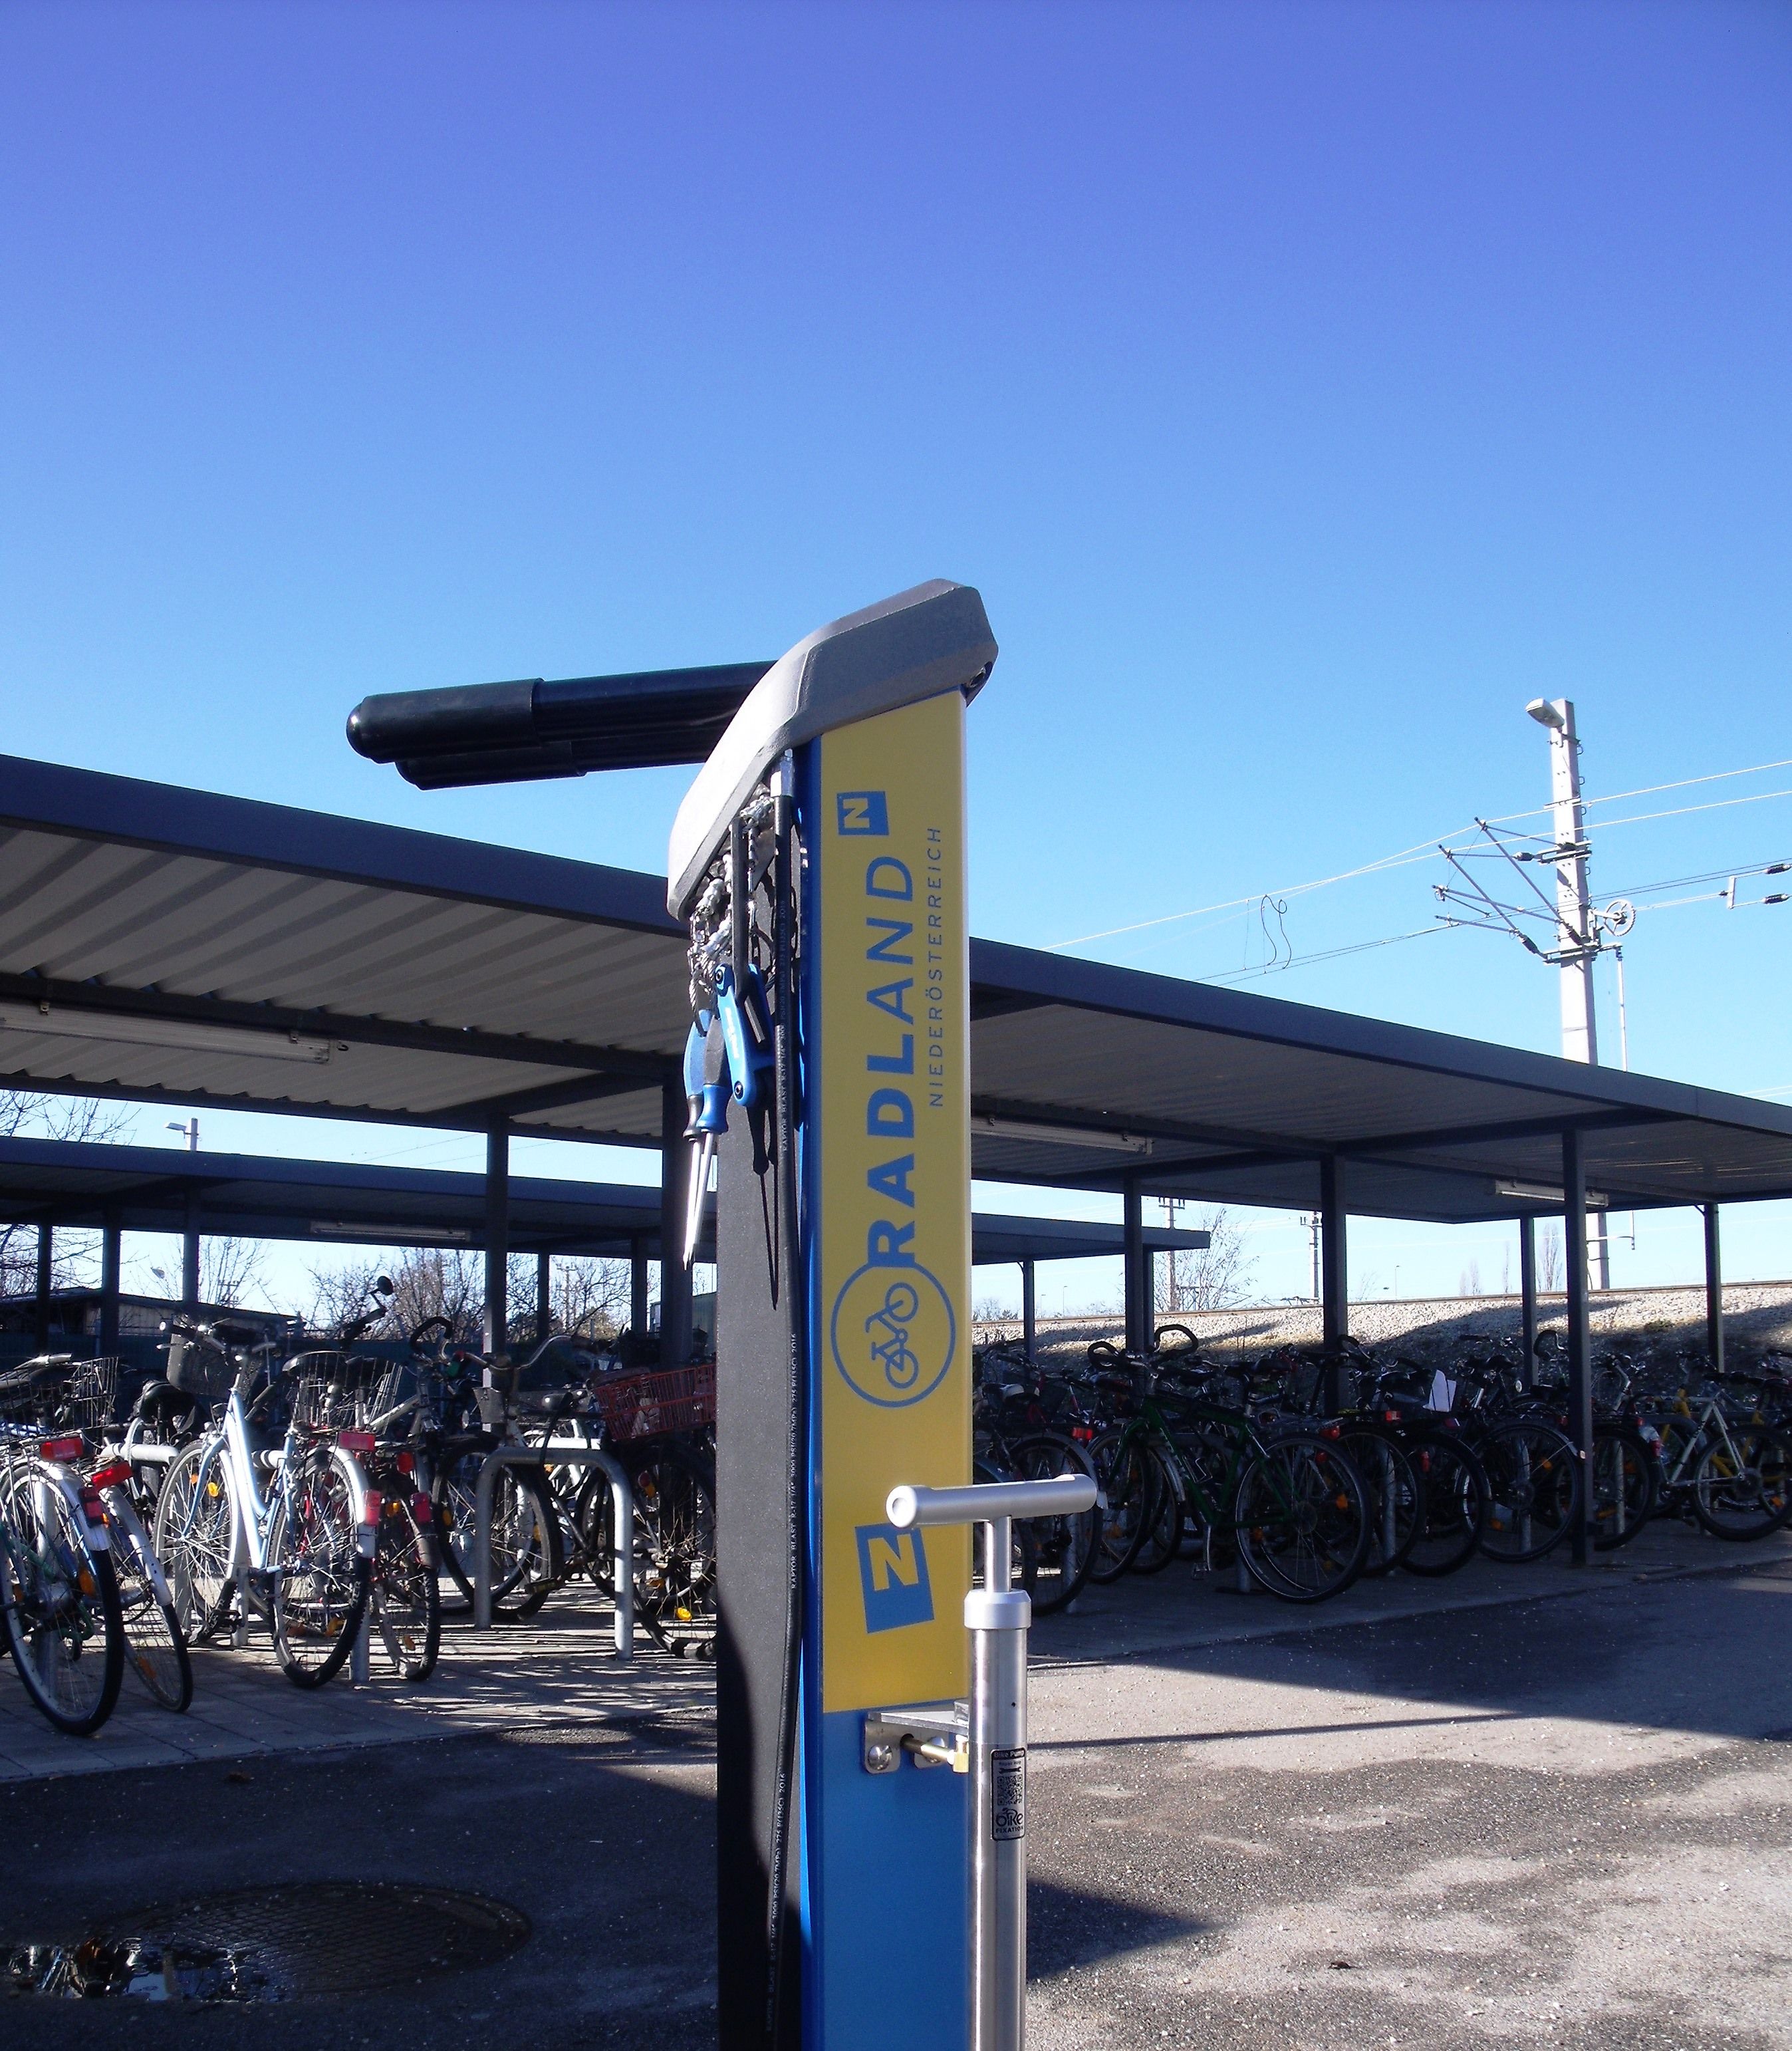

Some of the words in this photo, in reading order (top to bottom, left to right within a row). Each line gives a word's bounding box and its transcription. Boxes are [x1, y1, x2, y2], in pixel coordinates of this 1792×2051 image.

[842, 797, 870, 829] N
[926, 827, 944, 1107] NIEDERÖSTERREICH
[866, 855, 915, 1268] RADLAND
[867, 1533, 919, 1591] N
